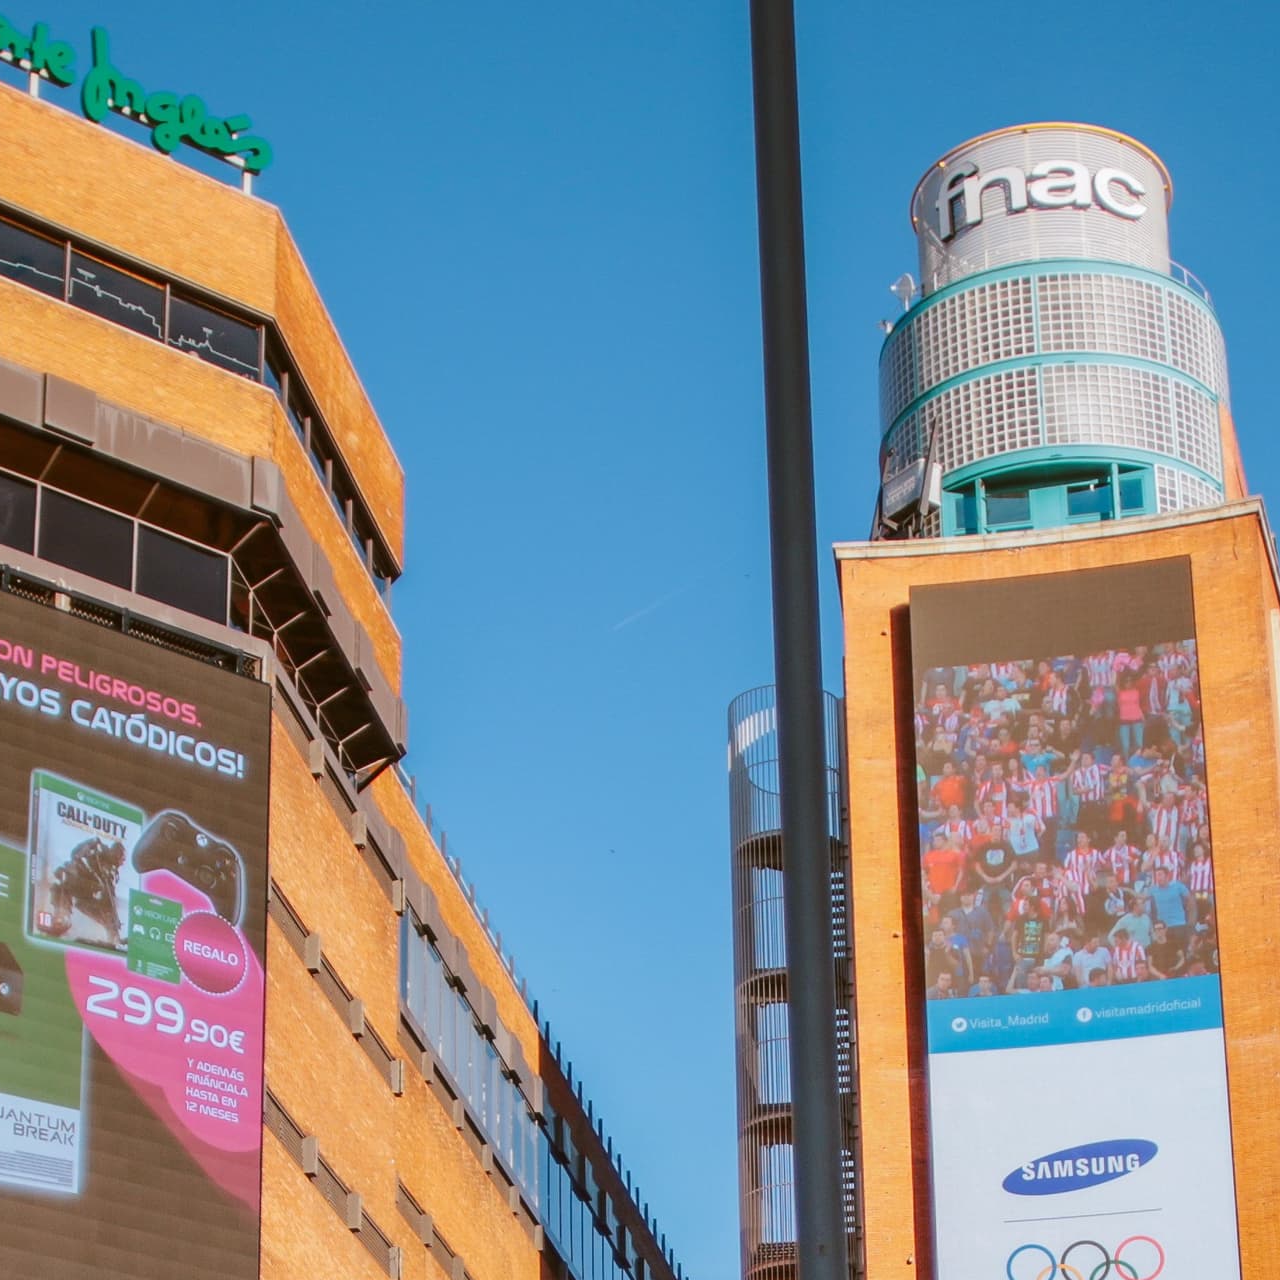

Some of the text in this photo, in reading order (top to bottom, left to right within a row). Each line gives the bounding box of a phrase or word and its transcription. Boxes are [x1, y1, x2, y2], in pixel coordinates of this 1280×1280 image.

[935, 159, 1148, 242] fnac
[41, 654, 202, 728] PELIGROSOS.
[70, 699, 245, 779] CATÓDICOS!
[183, 939, 239, 966] REGALO
[86, 975, 245, 1055] 299,90€
[187, 1057, 245, 1081] Y ADEMÁS
[186, 1086, 237, 1108] HASTA EN
[185, 1100, 239, 1122] 12 MESES
[13, 1122, 74, 1146] BREAK
[1022, 1153, 1141, 1181] SAMSUNG
